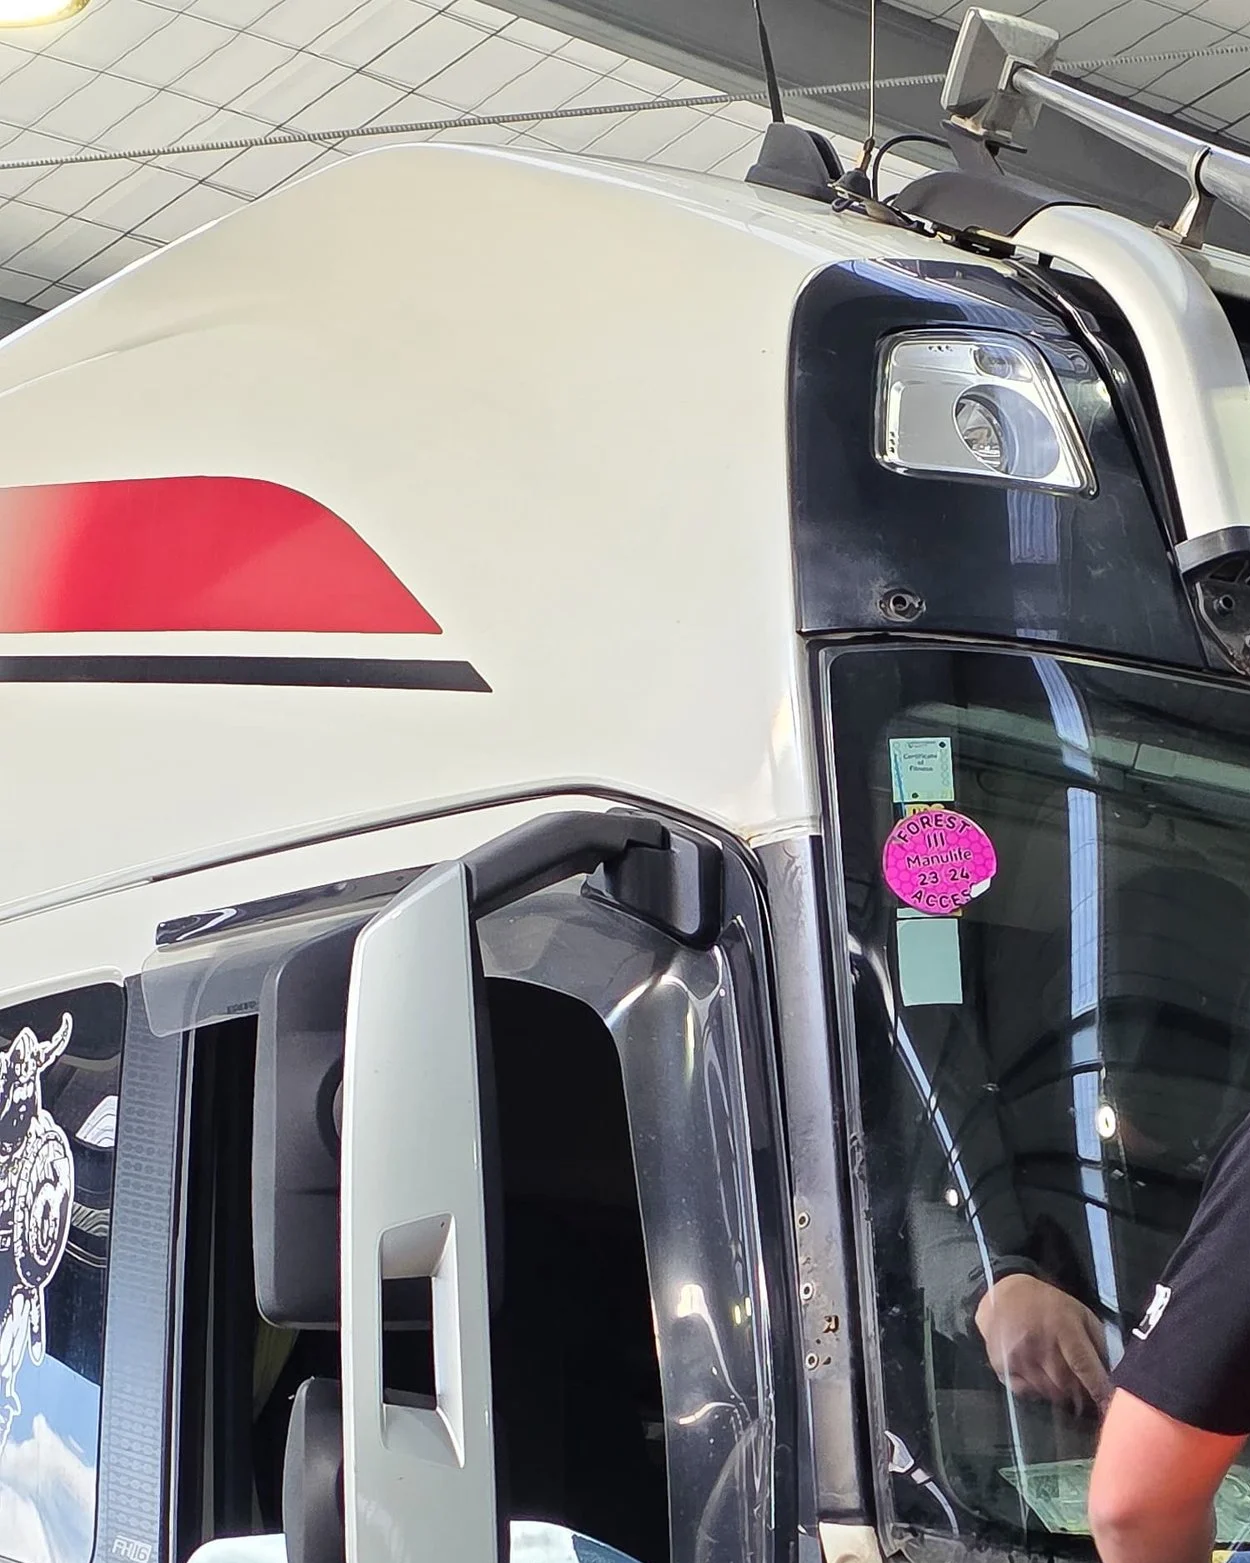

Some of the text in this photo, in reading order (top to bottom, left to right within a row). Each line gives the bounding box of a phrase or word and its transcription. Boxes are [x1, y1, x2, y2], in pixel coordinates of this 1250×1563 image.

[897, 814, 970, 843] FOREST
[906, 848, 972, 869] Manulife
[918, 868, 970, 886] 23 24
